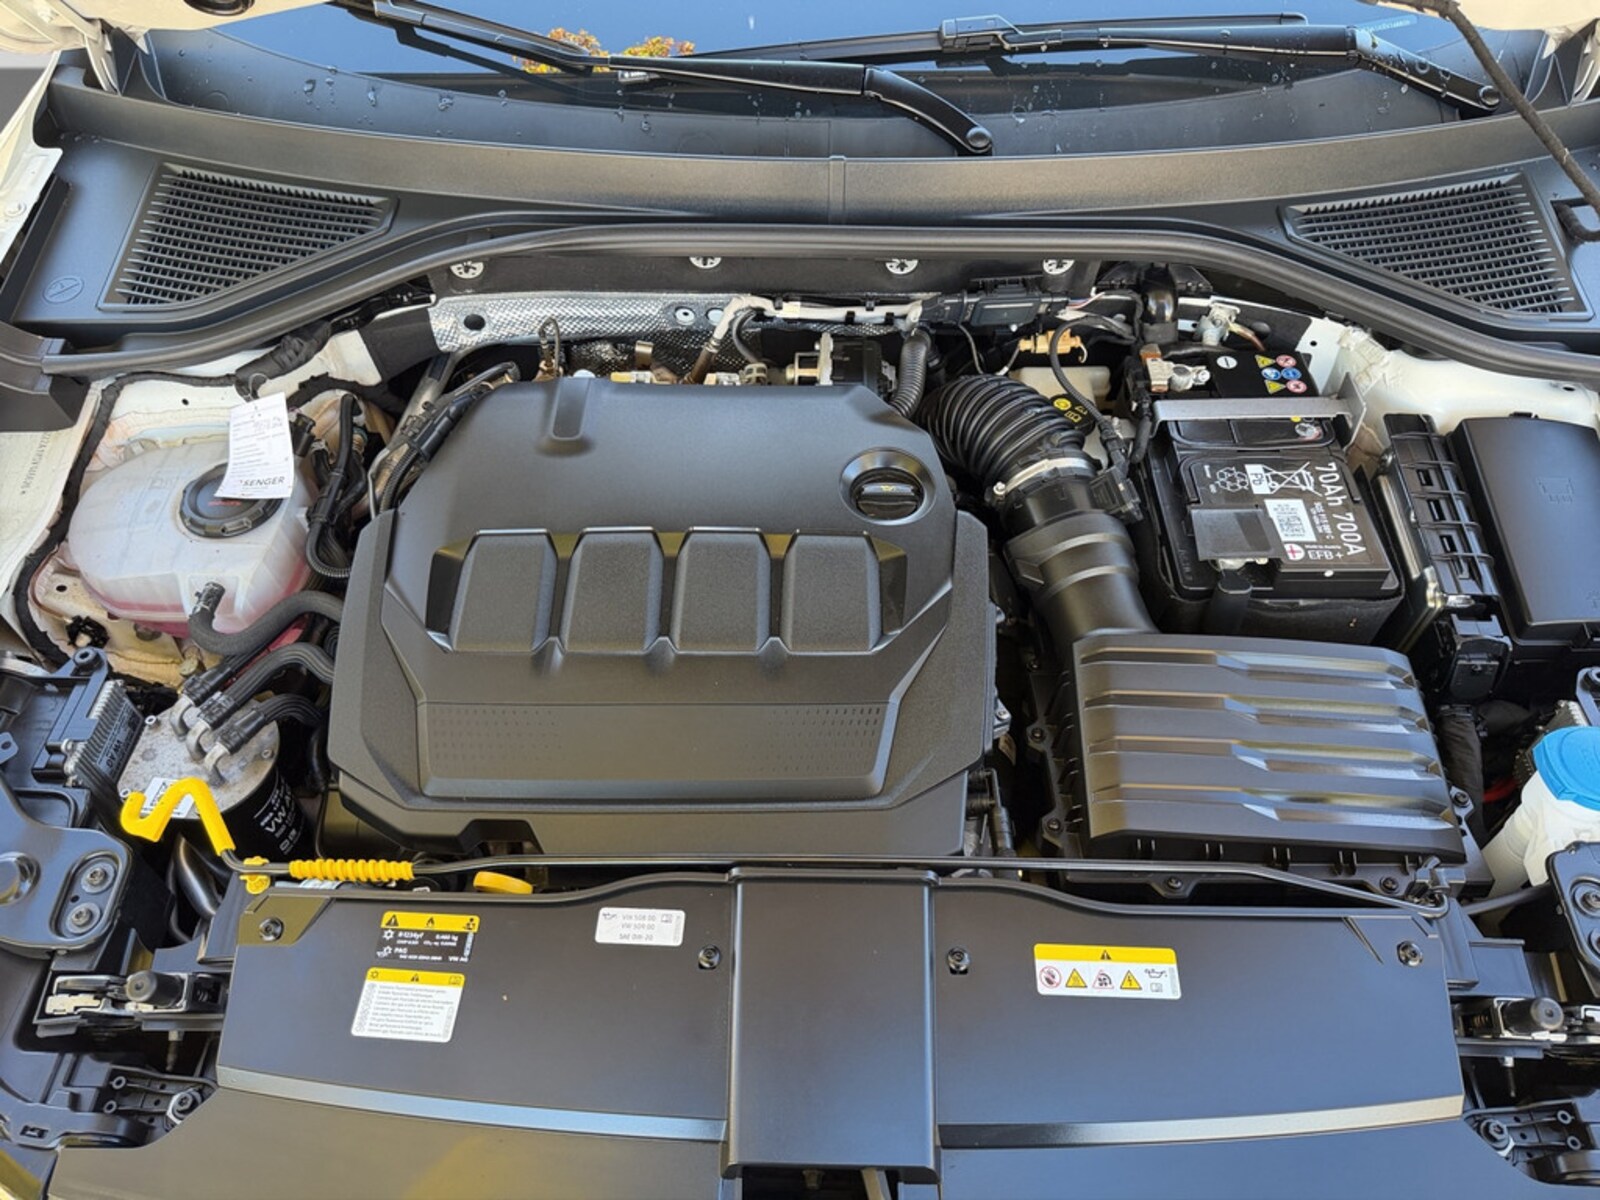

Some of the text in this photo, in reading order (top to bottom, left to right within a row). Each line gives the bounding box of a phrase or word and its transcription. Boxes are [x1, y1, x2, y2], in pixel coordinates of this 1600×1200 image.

[243, 476, 285, 486] SENGER
[1250, 472, 1264, 486] Pb
[1315, 462, 1347, 507] 70Ah
[1332, 512, 1366, 556] 700A
[265, 805, 286, 832] VW
